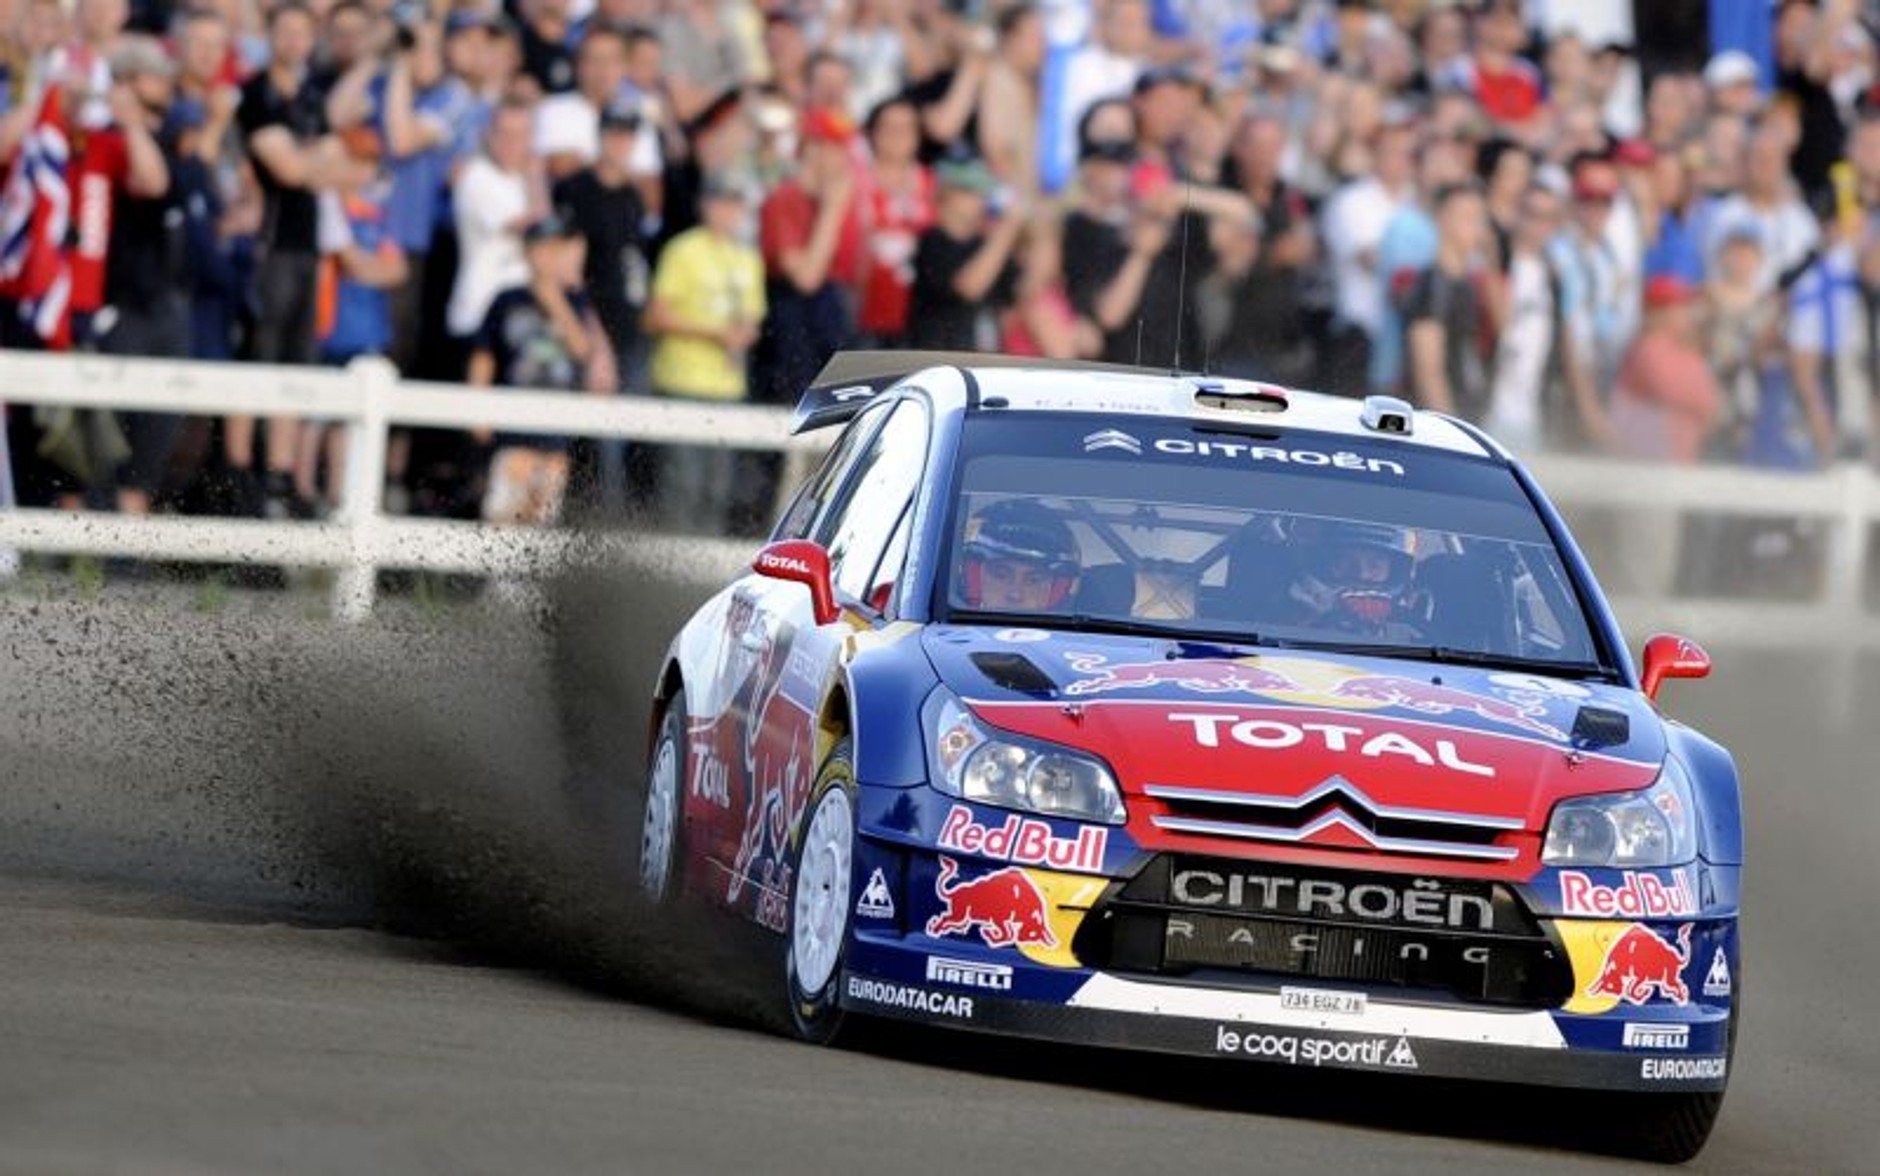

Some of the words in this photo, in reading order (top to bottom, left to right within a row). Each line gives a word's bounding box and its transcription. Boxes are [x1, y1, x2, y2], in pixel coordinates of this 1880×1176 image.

[760, 553, 811, 572] TOTAL
[1168, 712, 1495, 776] TOTAL
[926, 955, 1013, 990] PIRELLI
[848, 977, 973, 1018] EURODATACAR
[1216, 1025, 1240, 1052] le
[1244, 1033, 1298, 1064] coq
[1301, 1038, 1387, 1066] sportif
[1622, 1023, 1690, 1049] PIRELLI
